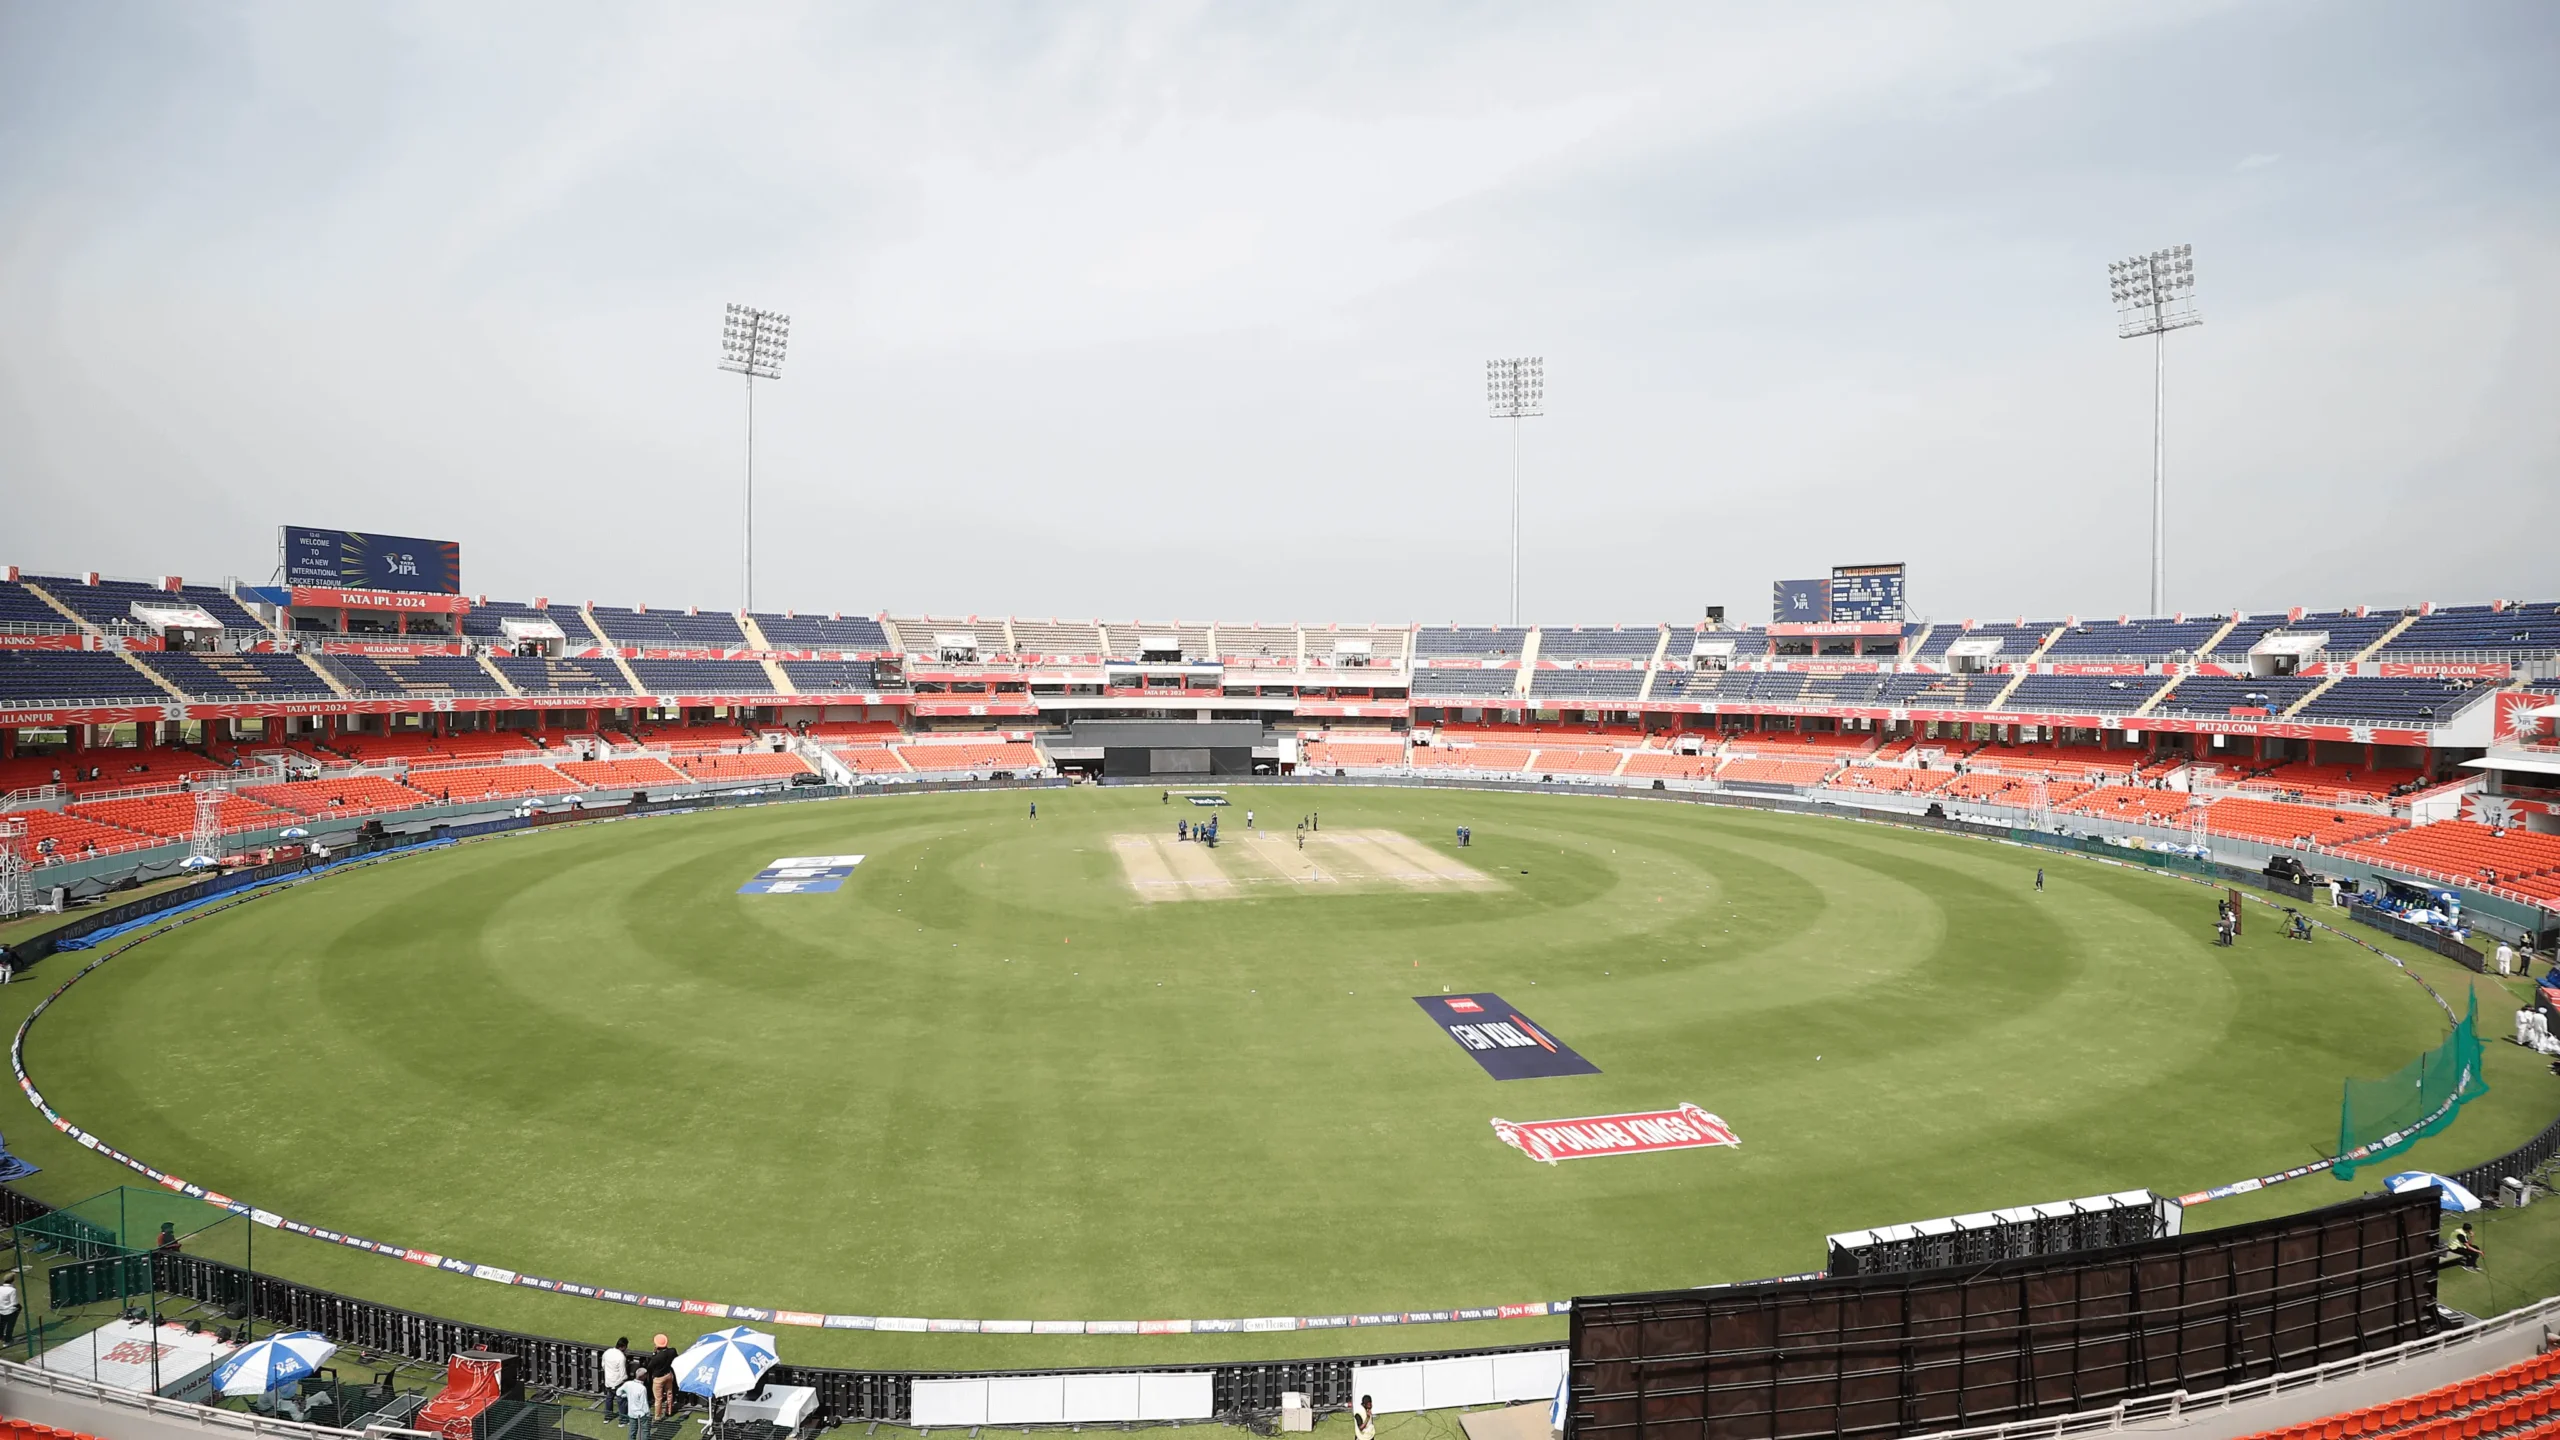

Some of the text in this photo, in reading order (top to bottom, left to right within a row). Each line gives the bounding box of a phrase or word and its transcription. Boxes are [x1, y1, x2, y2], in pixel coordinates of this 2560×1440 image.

[300, 537, 330, 547] WELCOME
[310, 548, 320, 556] TO
[301, 557, 314, 565] PCA
[292, 567, 338, 577] INTERNATIONAL
[399, 565, 419, 576] IPL
[289, 577, 341, 587] CRICKET STADIUM
[340, 593, 426, 608] TATA IPL 2024
[1804, 625, 1861, 633] MULLANPUR
[5, 636, 35, 645] KINGS
[364, 645, 409, 653] MULLANPUR
[2081, 665, 2115, 674] #TATAIPL
[2413, 665, 2477, 675] IPLT20.COM
[533, 698, 587, 707] PUNJAB KINGS
[285, 703, 347, 713] TATA IPL 2024
[1776, 706, 1829, 714] PUNJAB KINGS
[1983, 714, 2019, 722] MULLANPUR
[2195, 722, 2258, 734] IPLT20.COM
[802, 786, 841, 798] ASTRAL
[637, 804, 654, 812] TATA
[450, 816, 531, 837] AngelOne AngelOne
[65, 925, 83, 939] TATA
[1449, 1022, 1538, 1050] TATA NEU
[1538, 1116, 1703, 1152] PUNJAB KINGS
[443, 1258, 468, 1273] RuPay
[522, 1276, 553, 1288] TATA NEU
[562, 1283, 595, 1296] TATA NEU
[604, 1291, 638, 1302] TATA NEU
[647, 1298, 682, 1309] TATA NEU
[688, 1303, 727, 1314] FAN PARK
[733, 1307, 763, 1321] RuPay
[1460, 1309, 1498, 1319] TATA NEU
[1507, 1304, 1546, 1316] FAN PARK
[785, 1313, 823, 1325] AngelOne
[1307, 1317, 1347, 1327] TATA NEU
[1359, 1314, 1398, 1324] TATA NEU
[1410, 1312, 1448, 1322] TATA NEU
[834, 1317, 874, 1328] AngelOne
[1198, 1319, 1231, 1332] RuPay
